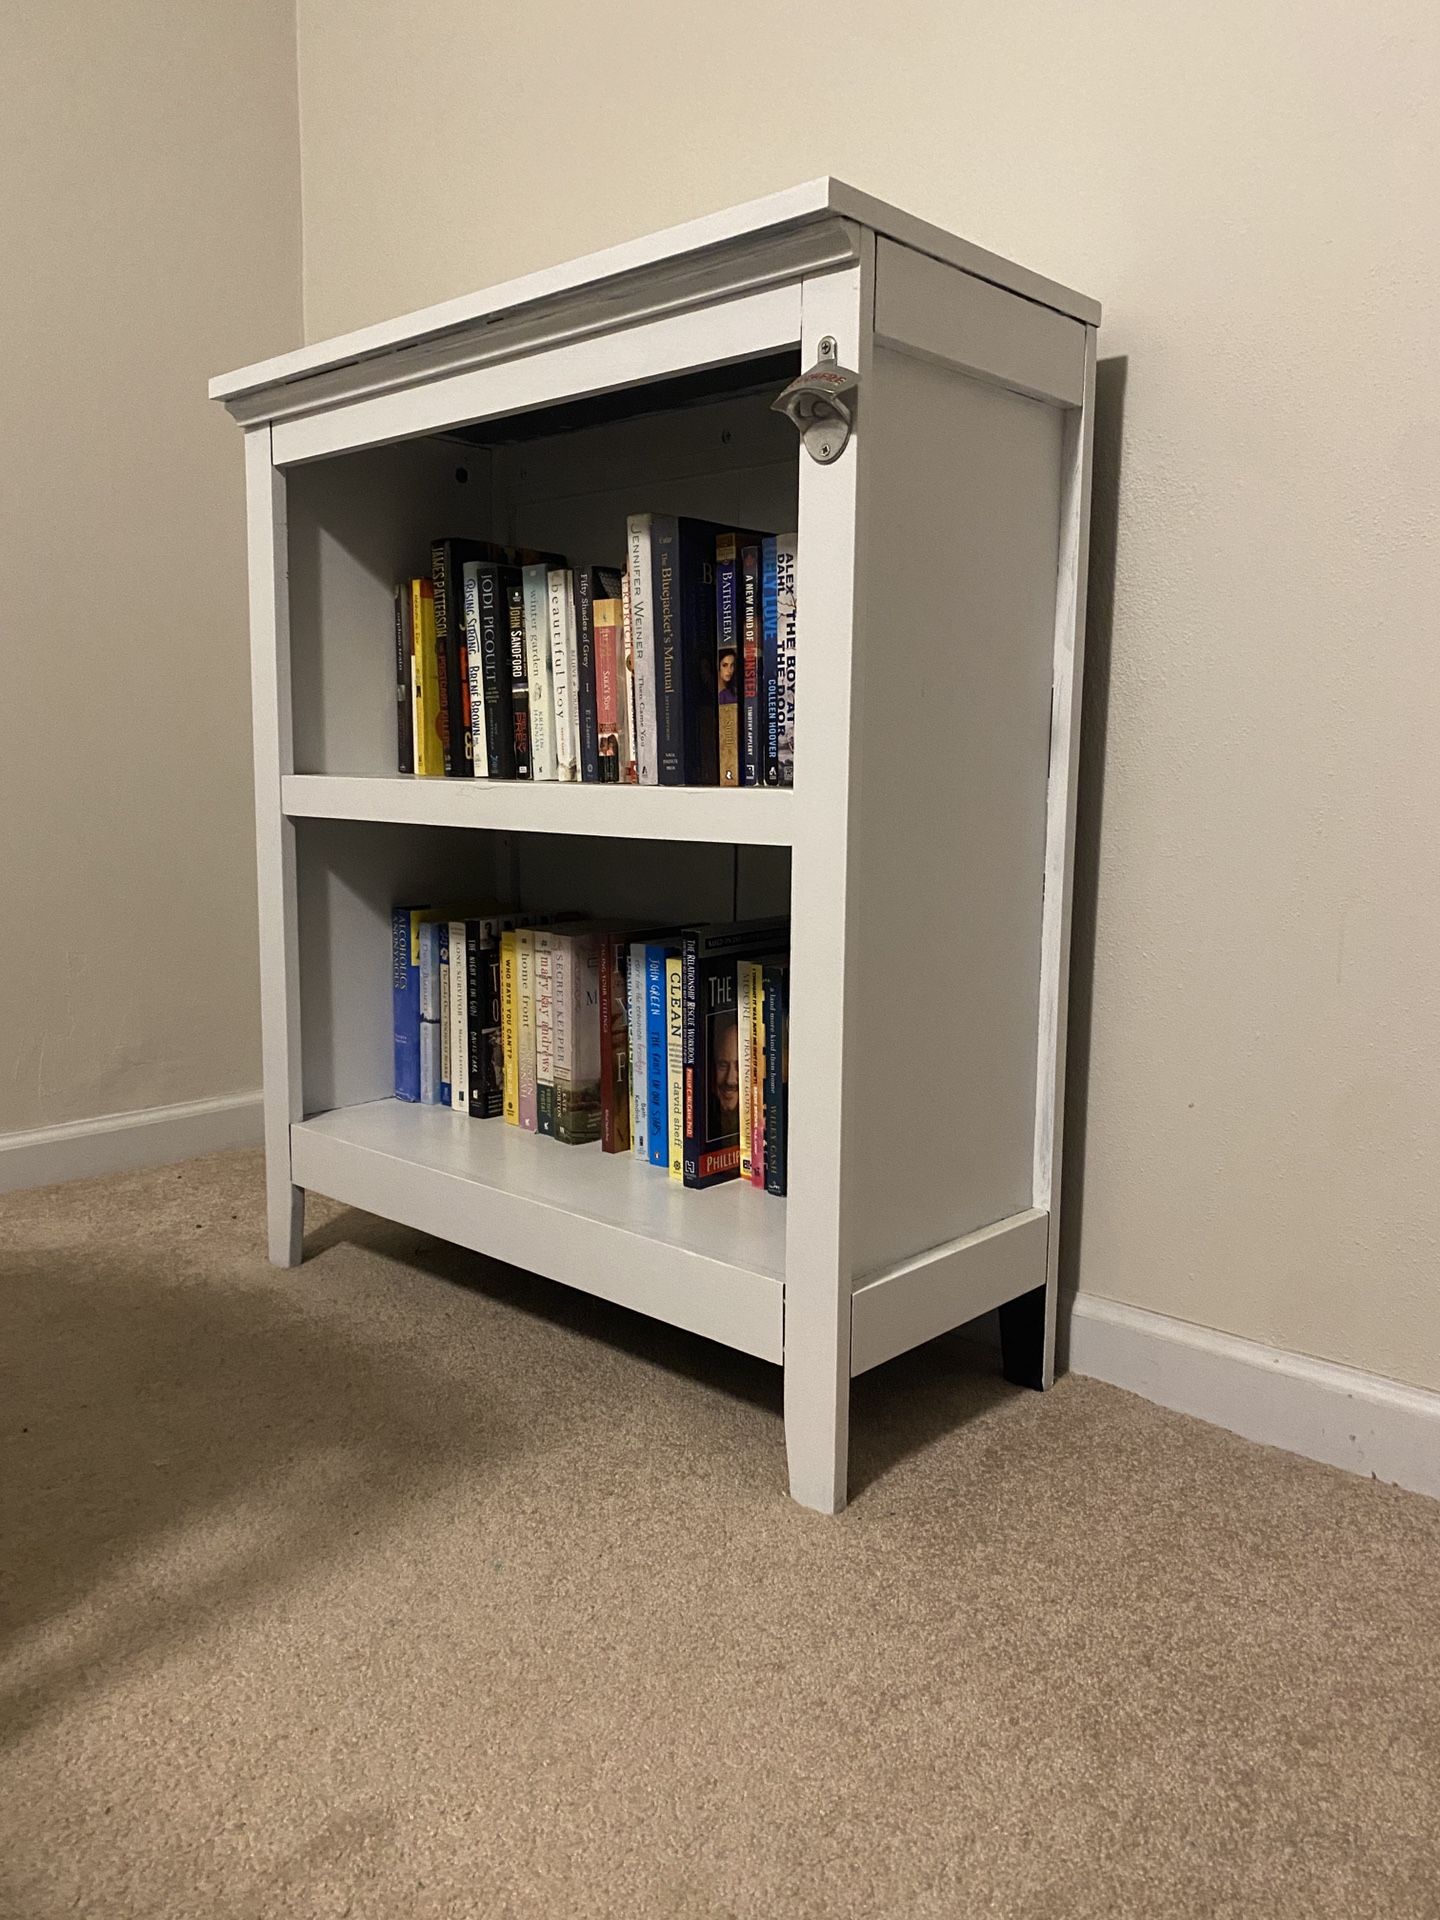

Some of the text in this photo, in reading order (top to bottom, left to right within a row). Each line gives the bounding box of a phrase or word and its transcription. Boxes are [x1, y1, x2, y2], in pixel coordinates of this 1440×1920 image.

[432, 547, 447, 638] JAMES PATTERSON
[480, 574, 497, 610] JODI
[630, 522, 646, 659] JENNIFER WEINER
[777, 553, 786, 597] DAHL
[785, 553, 794, 595] ALEX
[464, 579, 480, 656] RISING STRONG
[529, 589, 541, 677] winter garden
[551, 584, 566, 676] beautiful
[580, 574, 591, 669] Fifty Shades of Grey
[660, 568, 674, 644] Bluejacket's
[721, 571, 733, 642] BATHSHEBA
[763, 596, 778, 641] LOVE
[483, 616, 498, 684] PICOULT
[509, 606, 523, 678] JOHN SANDFORD
[745, 574, 757, 698] A NEW KIND OF MONSTER
[438, 656, 448, 708] POSTCARD
[469, 666, 482, 698] BRENÉ
[637, 675, 645, 699] Then
[663, 646, 675, 694] Manual
[777, 639, 786, 738] THE DOOR
[786, 609, 796, 725] THE BOY AT
[471, 700, 482, 736] BROWN
[555, 686, 567, 719] boy
[767, 679, 777, 758] COLLEEN HOOVER
[514, 712, 523, 752] PREY
[392, 915, 400, 988] ANONYMOUS
[399, 915, 408, 991] ALCOHOLICS
[455, 942, 463, 967] LONE
[469, 956, 477, 976] NIGHT
[469, 999, 479, 1017] GUN
[521, 952, 531, 1028] home front
[556, 953, 566, 1062] SECRET KEEPER
[649, 958, 661, 1016] JOHN GREEN
[670, 972, 682, 1037] CLEAN
[686, 939, 696, 1064] THE RELATIONSHIP RESCUE WORKBOOK
[708, 975, 732, 1007] THE
[742, 972, 751, 1022] MOORE
[769, 994, 777, 1011] land
[539, 956, 553, 1074] mary kay andrews
[650, 1030, 662, 1047] THE
[470, 1031, 479, 1074] DAVID CARR
[505, 1028, 513, 1060] CAN'T?
[743, 1038, 751, 1082] PRAYING
[640, 1102, 648, 1118] Beth
[673, 1082, 683, 1149] david sheff
[744, 1118, 752, 1149] WORD
[706, 1150, 740, 1173] PHILLIP
[770, 1105, 778, 1175] WILEY CASH
